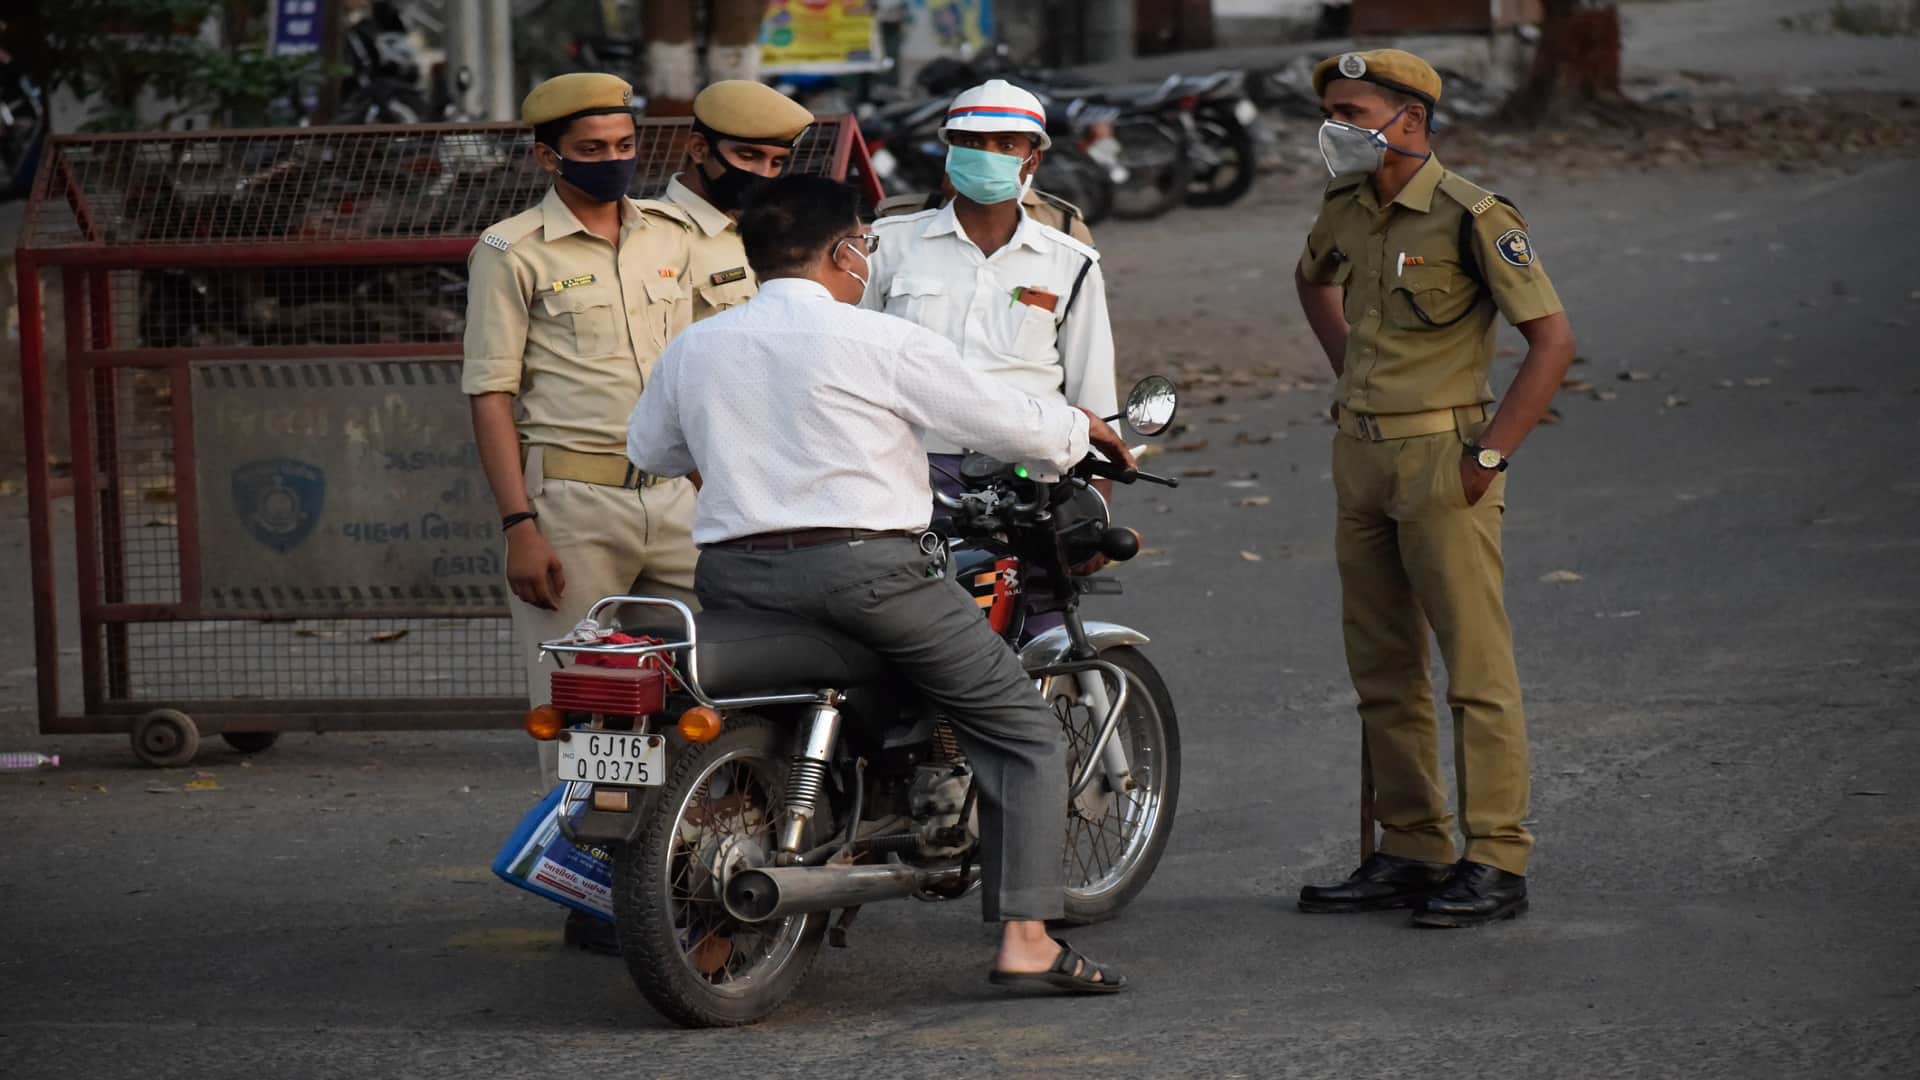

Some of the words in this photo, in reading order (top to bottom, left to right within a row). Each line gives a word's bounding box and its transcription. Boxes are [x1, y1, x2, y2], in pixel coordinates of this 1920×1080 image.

[1472, 195, 1496, 214] GHG
[343, 520, 411, 543] વાહન
[562, 752, 575, 760] IND
[590, 735, 641, 759] GJ16
[597, 759, 649, 783] 0375
